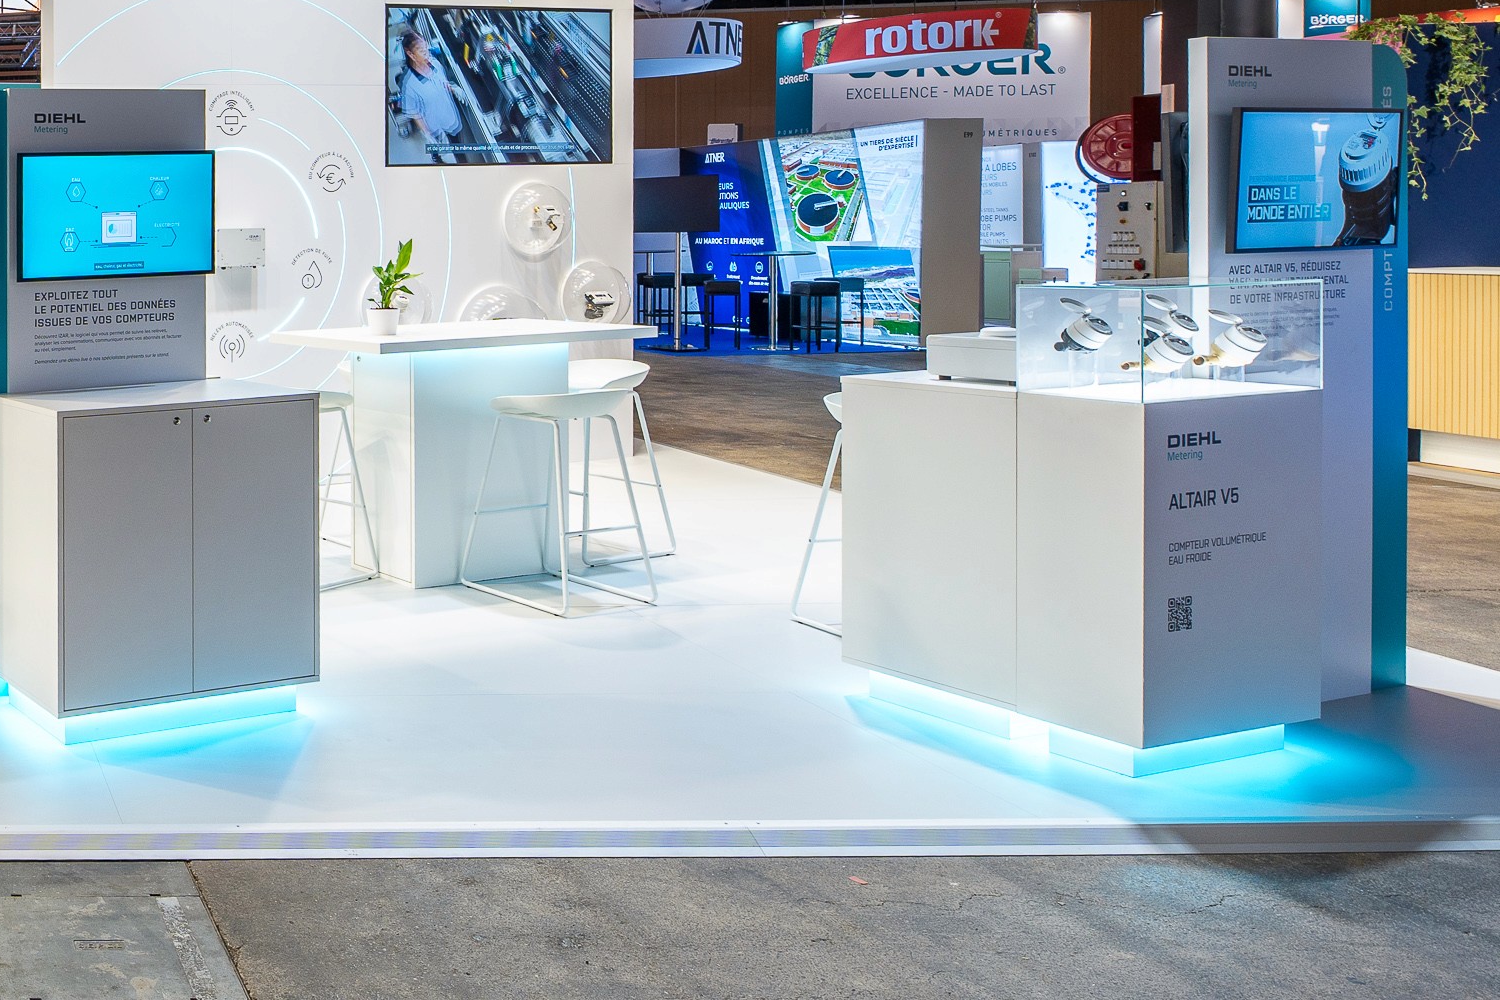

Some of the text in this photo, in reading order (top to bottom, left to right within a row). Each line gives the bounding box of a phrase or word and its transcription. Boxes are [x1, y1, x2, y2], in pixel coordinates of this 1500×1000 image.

[1310, 14, 1365, 24] BÖRGER
[864, 17, 1000, 56] rotork
[1228, 66, 1272, 77] DIEHL
[779, 74, 810, 86] BÖRGER
[1228, 79, 1258, 89] Metering
[846, 83, 1056, 100] EXCELLENCE MADE TO LAST
[208, 90, 228, 112] COMPTAGE
[34, 113, 86, 124] DIEHL
[34, 126, 68, 134] Metering
[894, 135, 914, 144] SIÈCLE
[878, 142, 914, 151] D'EXPERTISE
[310, 152, 331, 171] COMPTEUR
[704, 152, 725, 163] ATNER
[992, 162, 1017, 172] LOBES
[1251, 187, 1296, 200] DANS LE
[1248, 204, 1330, 220] MONDE ENTIER
[739, 238, 764, 246] AFRIQUE
[322, 252, 332, 264] FUITE
[1229, 260, 1341, 275] AVEC ALTAIR V5, RÉDUISEZ
[34, 290, 118, 301] EXPLOITEZ TOUT
[1230, 294, 1241, 304] DE
[1244, 293, 1271, 303] VOTRE
[34, 298, 176, 314] LE POTENTIEL DES DONNÉES
[34, 313, 175, 327] ISSUES DE VOS COMPTEURS
[1168, 431, 1221, 448] DIEHL
[1167, 450, 1202, 461] Metering
[1168, 487, 1239, 510] ALTAIR V5
[1169, 531, 1266, 552] COMPTEUR VOLUMÉTRIQUE
[1169, 552, 1212, 565] EAU FROIDE
